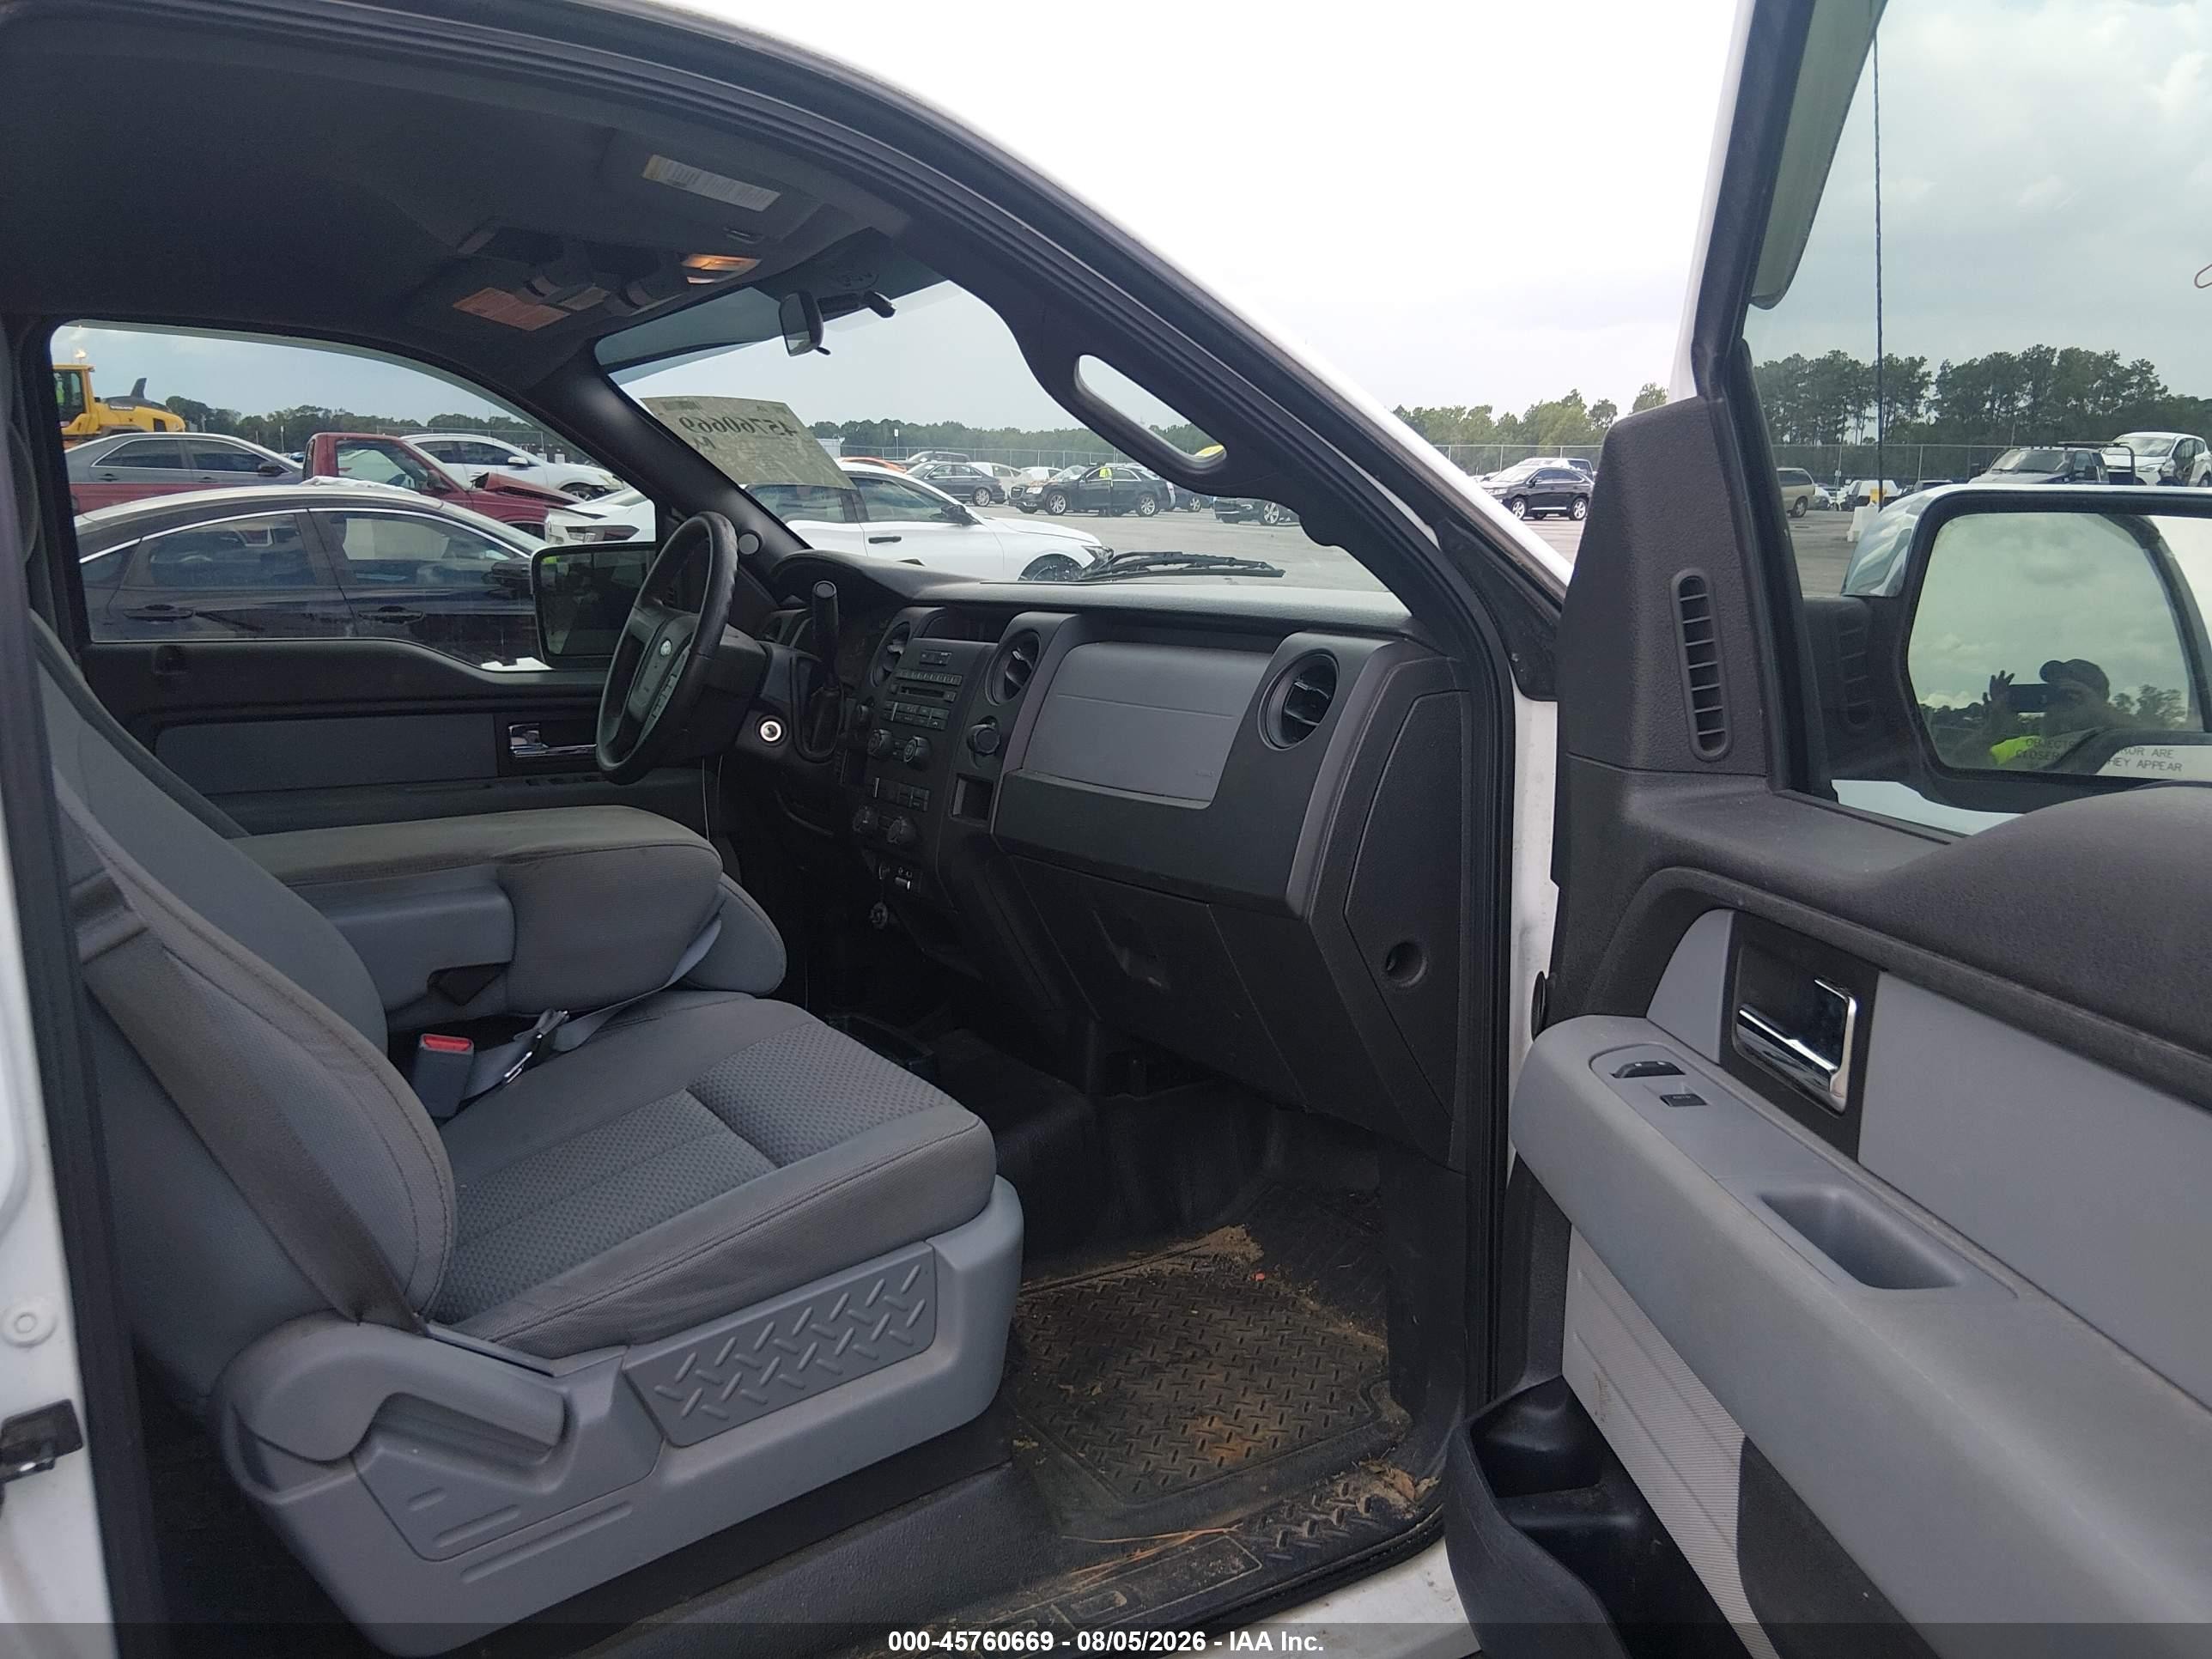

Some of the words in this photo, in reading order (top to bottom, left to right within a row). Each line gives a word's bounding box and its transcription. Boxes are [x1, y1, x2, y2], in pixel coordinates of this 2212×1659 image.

[2151, 748, 2175, 759] ARE
[2108, 757, 2131, 768] HEY
[2136, 759, 2184, 772] APPEAR
